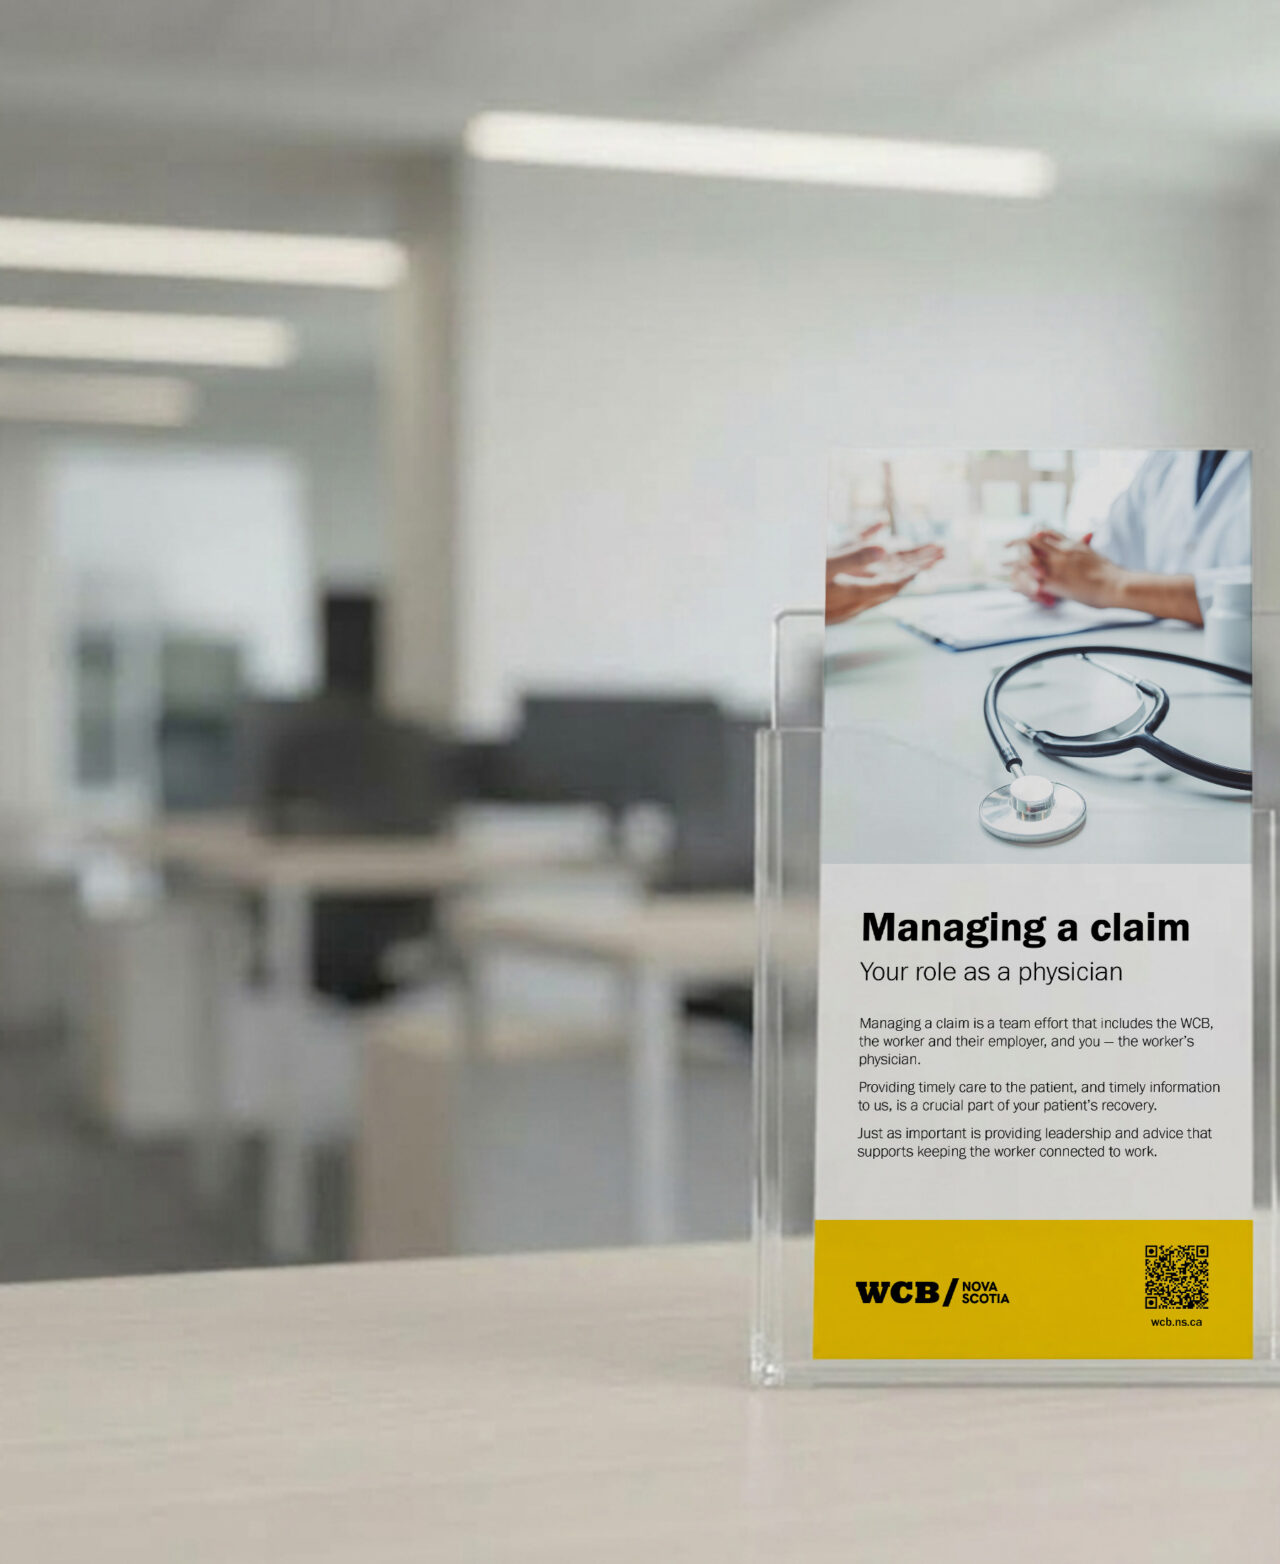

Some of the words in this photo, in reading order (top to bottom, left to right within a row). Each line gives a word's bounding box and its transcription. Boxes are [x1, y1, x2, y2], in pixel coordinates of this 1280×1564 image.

[863, 911, 1047, 949] Managing
[1057, 919, 1078, 942] a
[1091, 911, 1189, 942] claim
[860, 961, 909, 981] Your
[916, 961, 956, 981] role
[964, 966, 990, 981] as
[997, 966, 1010, 981] a
[1019, 961, 1122, 986] physician
[860, 1017, 922, 1032] Managing
[924, 1019, 932, 1029] a
[936, 1017, 970, 1029] claim
[973, 1017, 985, 1029] is
[987, 1019, 995, 1029] a
[999, 1018, 1031, 1029] team
[1034, 1016, 1069, 1029] effort
[1072, 1017, 1097, 1029] that
[1101, 1017, 1153, 1029] includes
[1156, 1017, 1177, 1029] the
[1180, 1017, 1213, 1030] WCB,
[859, 1053, 921, 1068] physician.
[859, 1081, 916, 1096] Providing
[918, 1081, 956, 1095] timely
[959, 1083, 987, 1093] care
[989, 1082, 1002, 1093] to
[1005, 1081, 1026, 1093] the
[1030, 1081, 1077, 1095] patient,
[1081, 1081, 1105, 1093] and
[1108, 1081, 1146, 1095] timely
[1150, 1080, 1220, 1093] information
[857, 1127, 883, 1139] Just
[886, 1129, 902, 1139] as
[906, 1127, 967, 1141] important
[971, 1127, 981, 1139] is
[985, 1127, 1042, 1142] providing
[1045, 1127, 1112, 1141] leadership
[1115, 1127, 1139, 1139] and
[1142, 1127, 1184, 1139] advice
[1186, 1127, 1212, 1139] that
[857, 1146, 914, 1160] supports
[917, 1145, 967, 1160] keeping
[969, 1145, 991, 1158] the
[994, 1145, 1036, 1158] worker
[1039, 1145, 1105, 1158] connected
[1108, 1146, 1121, 1158] to
[1124, 1145, 1157, 1158] work.
[962, 1281, 998, 1292] NOVA
[962, 1293, 1010, 1304] SCOTIA
[1150, 1317, 1202, 1327] wcb.ns.ca
